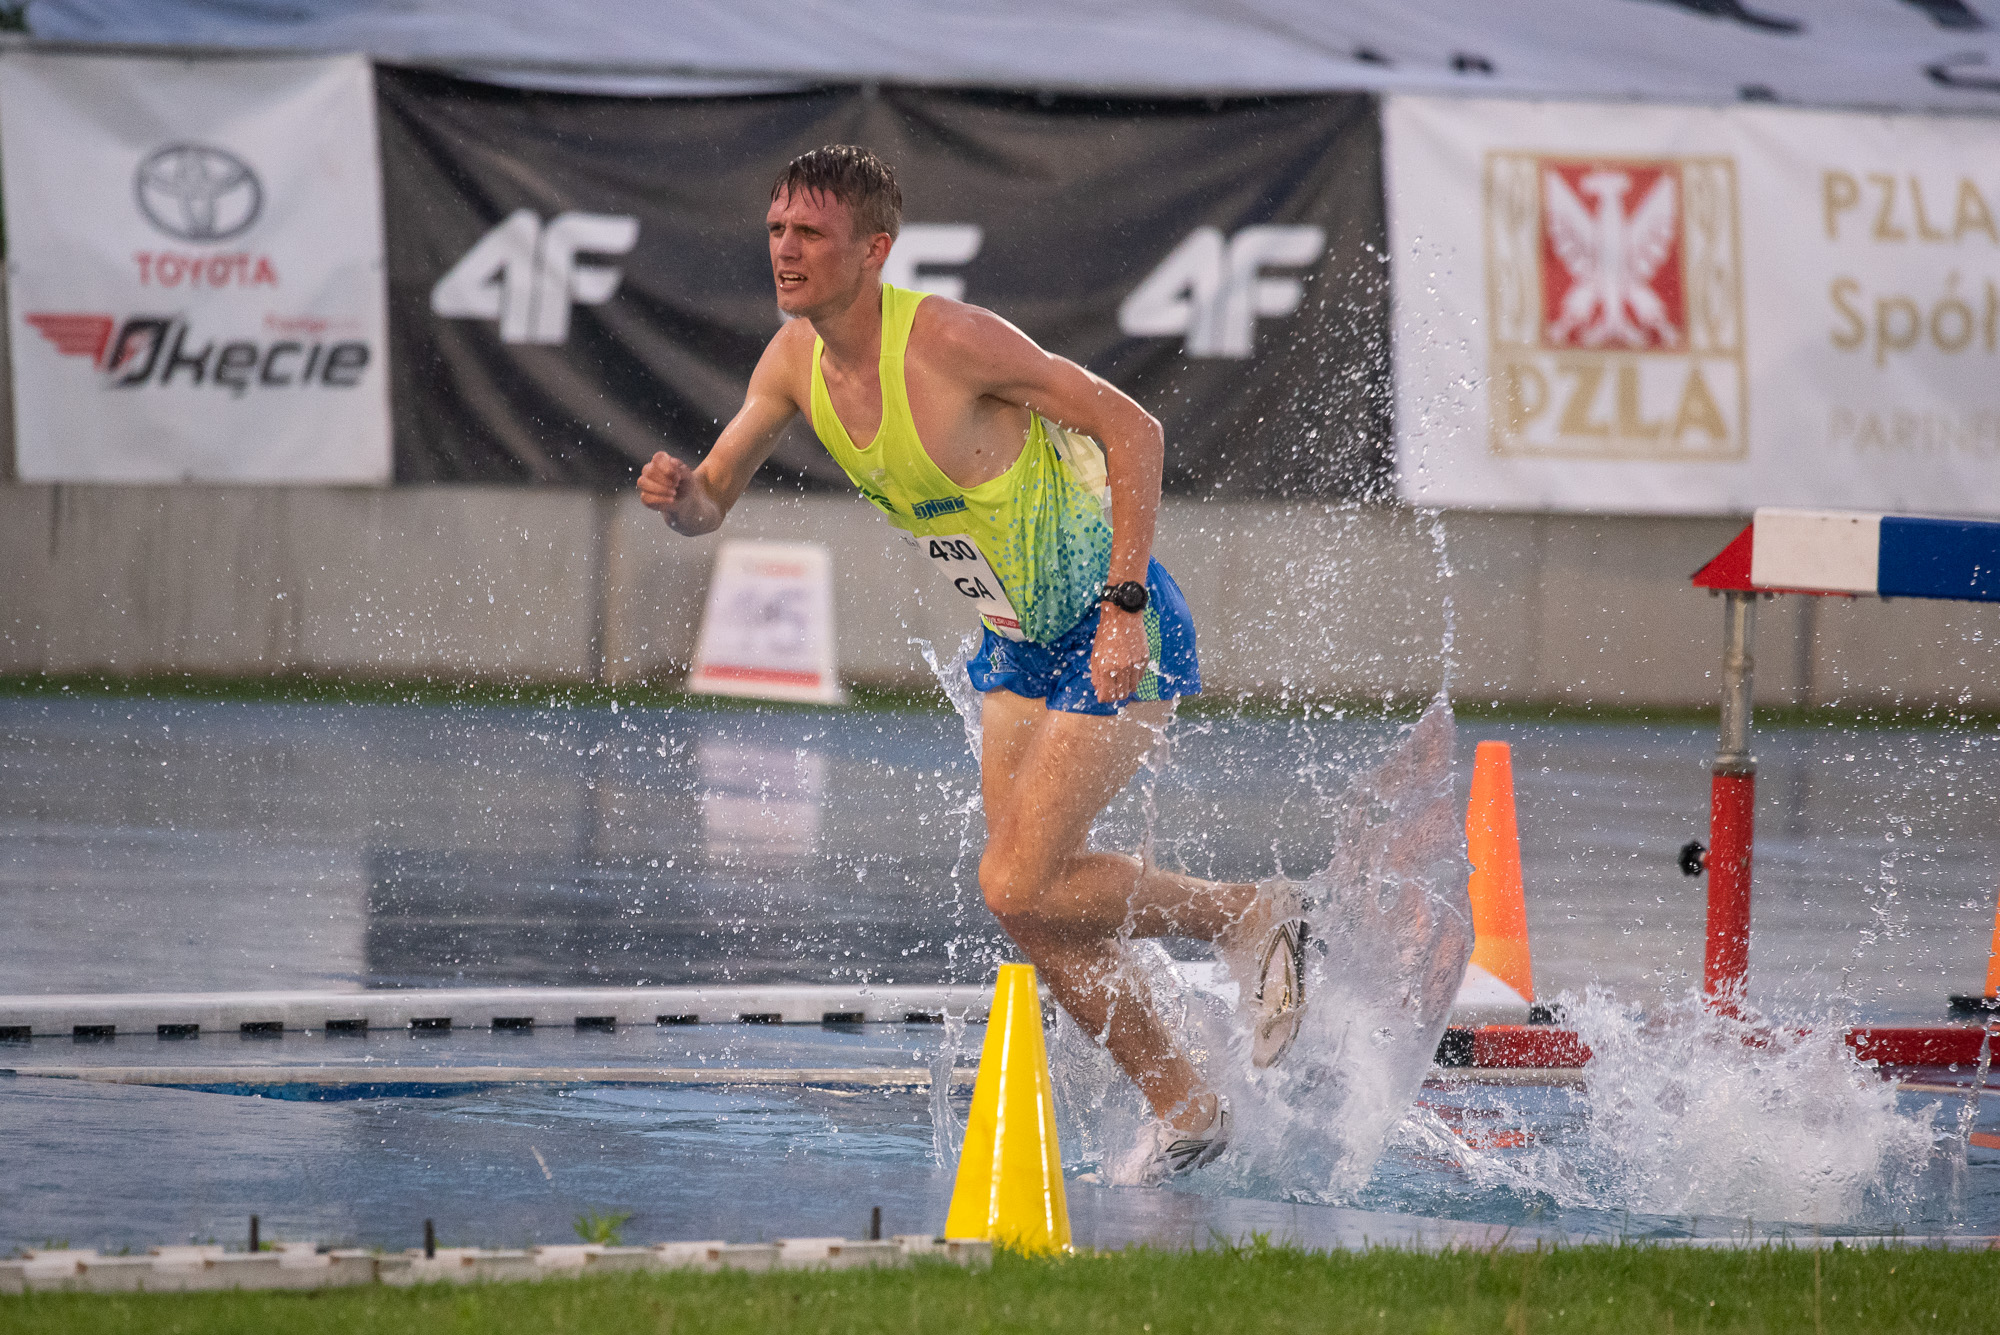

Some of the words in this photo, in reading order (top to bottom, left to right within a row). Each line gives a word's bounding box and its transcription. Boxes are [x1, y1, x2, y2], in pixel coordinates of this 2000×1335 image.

[1822, 169, 2000, 243] PZLA
[135, 251, 279, 288] TOYOTA
[430, 208, 640, 345] 4F
[1118, 225, 1326, 359] 4F
[1507, 366, 1728, 437] PZLA
[930, 540, 977, 561] 430
[954, 577, 996, 600] GA
